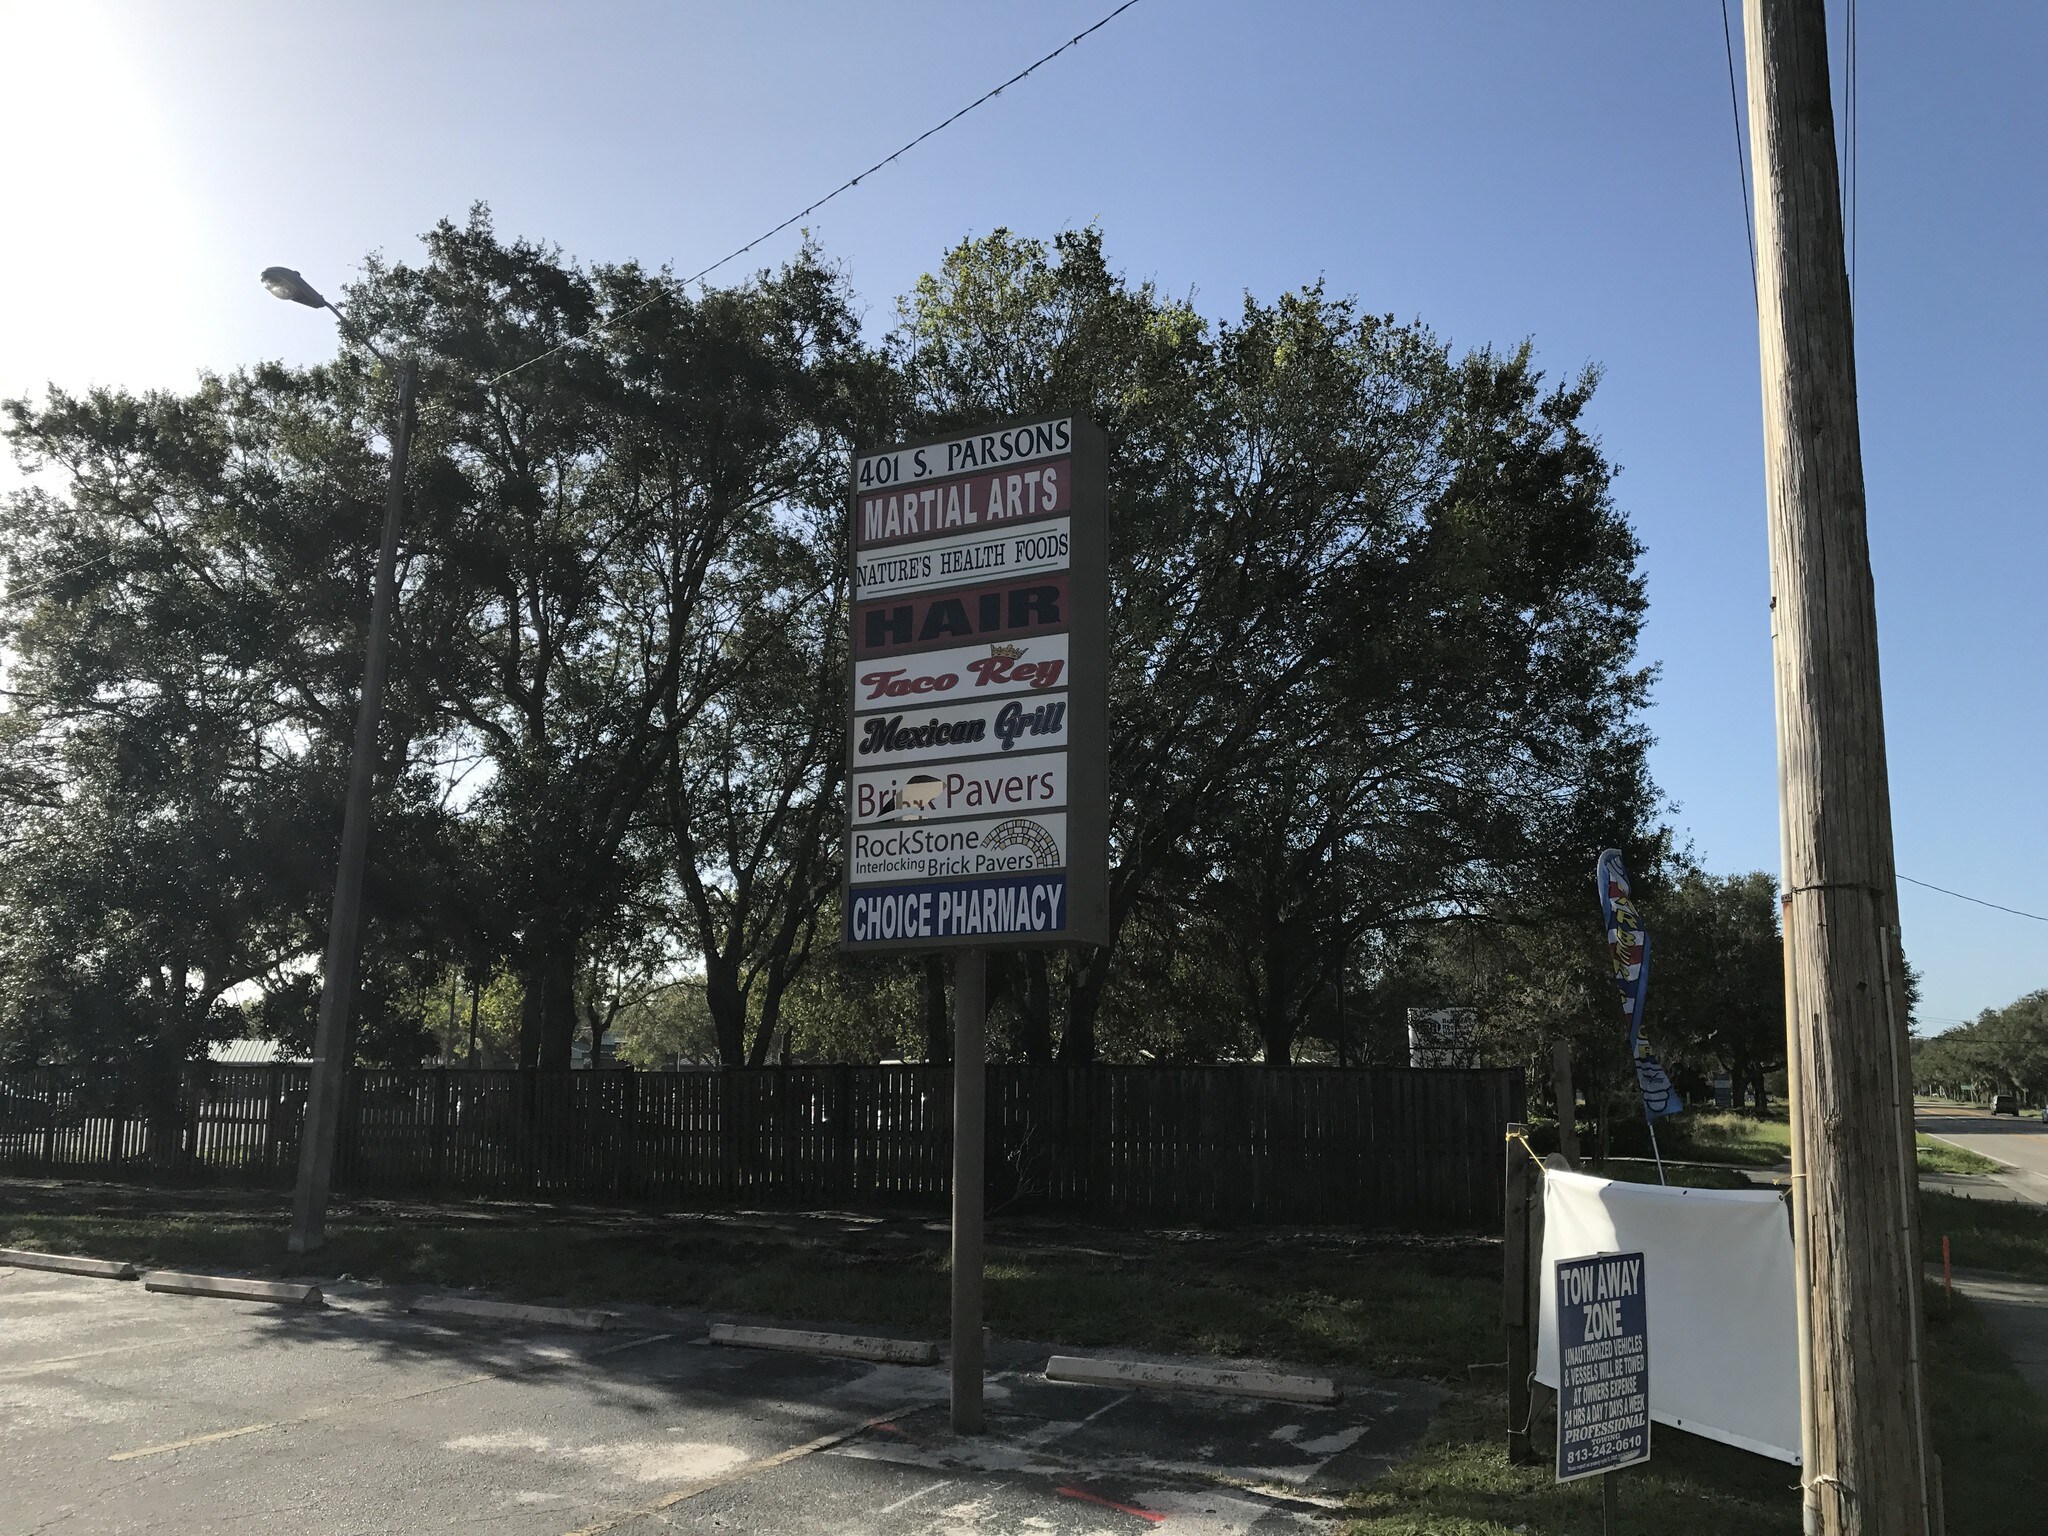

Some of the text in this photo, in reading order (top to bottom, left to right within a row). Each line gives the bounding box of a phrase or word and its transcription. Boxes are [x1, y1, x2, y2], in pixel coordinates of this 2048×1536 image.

[859, 420, 1070, 486] 401 S. PARSONS
[864, 467, 1057, 541] MARTIAL ARTS
[856, 533, 1069, 587] NATURE'S HEALTH FOODS
[865, 585, 1061, 648] HAIR
[860, 656, 1065, 700] Taco Rey
[858, 700, 1066, 755] Mexican Grill
[946, 771, 1054, 809] Pavers
[855, 830, 979, 858] RockStone
[856, 854, 1033, 876] Interlocking Brick Pavers
[852, 883, 1062, 941] CHOICE PHARMACY
[1560, 1259, 1640, 1307] TOW AWAY
[1583, 1300, 1623, 1342] ZONE
[1564, 1334, 1643, 1366] UNAUTHORIZED VEHICLES
[1564, 1354, 1645, 1388] & VESSELS WILL BE TOWED
[1573, 1375, 1637, 1406] AT OWNERS EXPENSE
[1564, 1393, 1645, 1429] 24 HRS A DAY 7 DAYS A WEEK
[1564, 1413, 1645, 1445] PROFESSIONAL
[1567, 1435, 1641, 1464] 813-242-0610
[1591, 1433, 1621, 1446] TOWING
